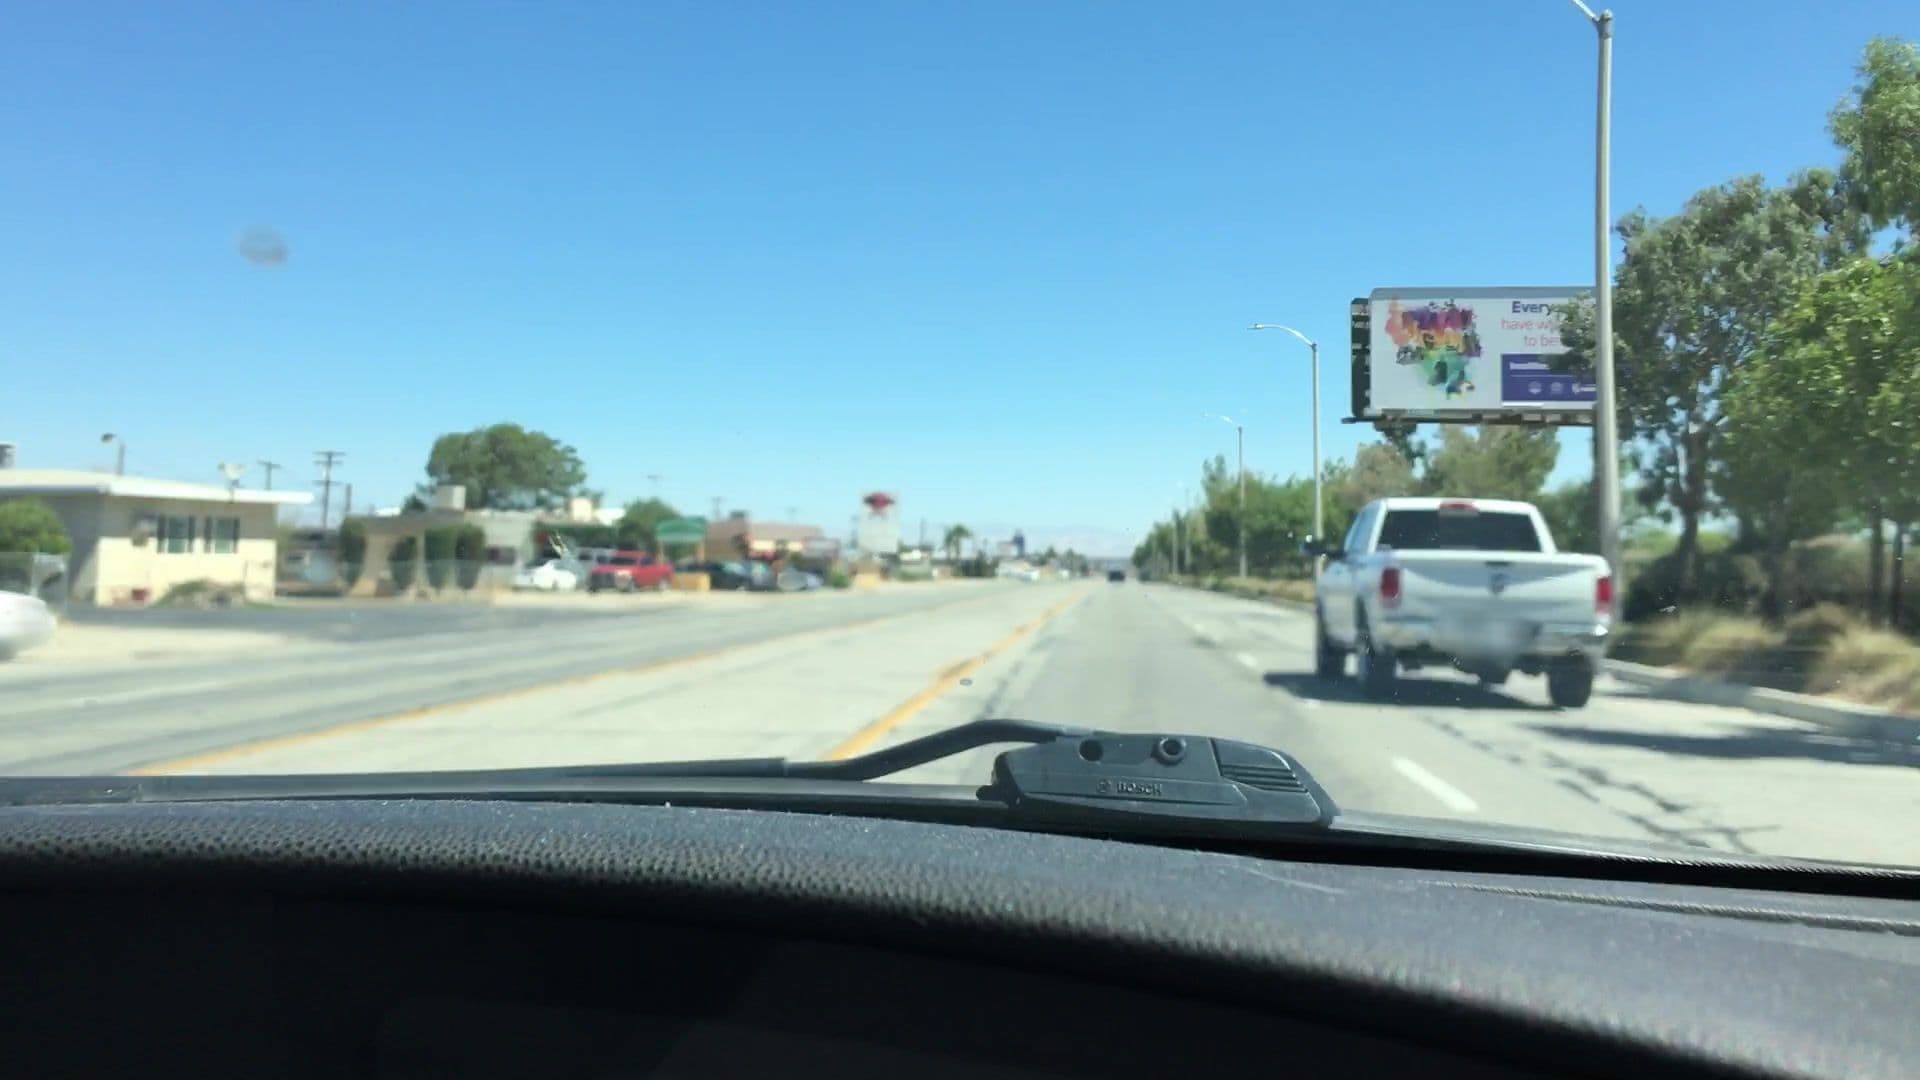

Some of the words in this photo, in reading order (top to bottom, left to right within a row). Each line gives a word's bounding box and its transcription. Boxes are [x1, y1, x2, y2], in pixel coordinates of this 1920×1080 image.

[1511, 300, 1553, 316] Every
[1524, 335, 1537, 346] to
[1117, 782, 1162, 796] BOSCH
